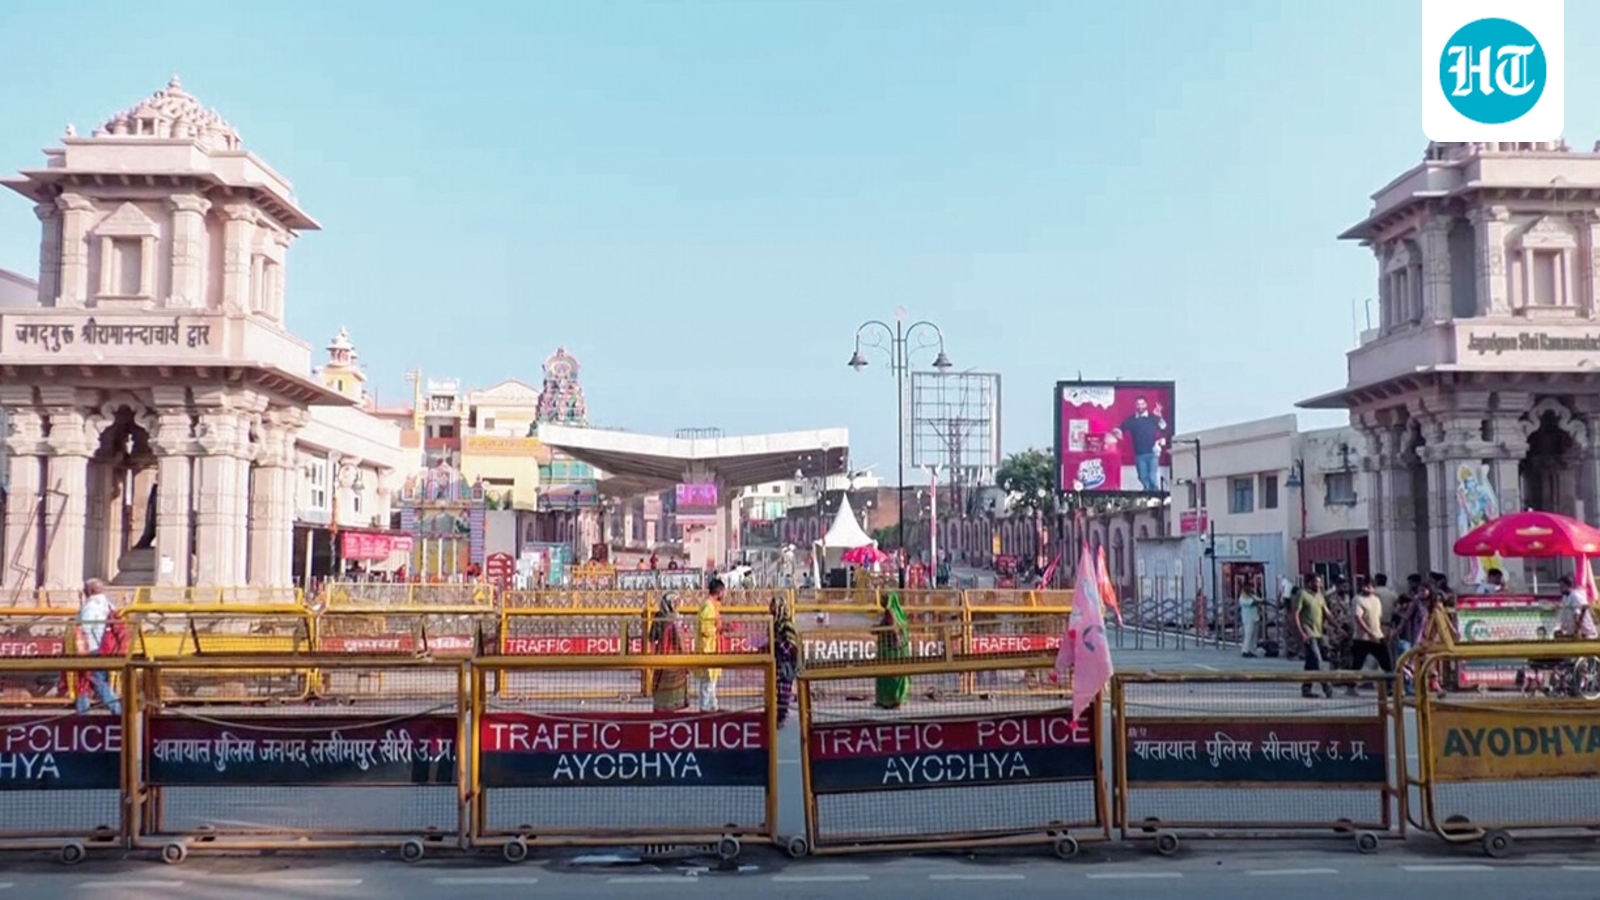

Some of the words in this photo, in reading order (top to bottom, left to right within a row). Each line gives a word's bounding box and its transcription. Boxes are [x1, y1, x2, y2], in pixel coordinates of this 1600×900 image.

[187, 325, 210, 347] द्वार
[508, 638, 571, 653] TRAFFIC
[587, 638, 642, 653] POLIE
[802, 639, 876, 660] TRAFFIC
[6, 725, 122, 751] POLICE
[489, 723, 622, 749] TRAFFIC
[650, 722, 761, 749] POLICE
[814, 723, 944, 754] TRAFFIC
[978, 717, 1090, 747] POLICE
[1134, 740, 1197, 761] यातायात
[1205, 731, 1253, 767] पुलिस
[1260, 731, 1321, 768] सीतापुर
[1444, 725, 1600, 758] AYODHYA
[153, 738, 211, 763] यातायात
[214, 731, 256, 771] पुलिस
[259, 739, 310, 768] जनपद
[553, 752, 702, 780] AYODHYA
[882, 751, 1030, 784] AYODHYA
